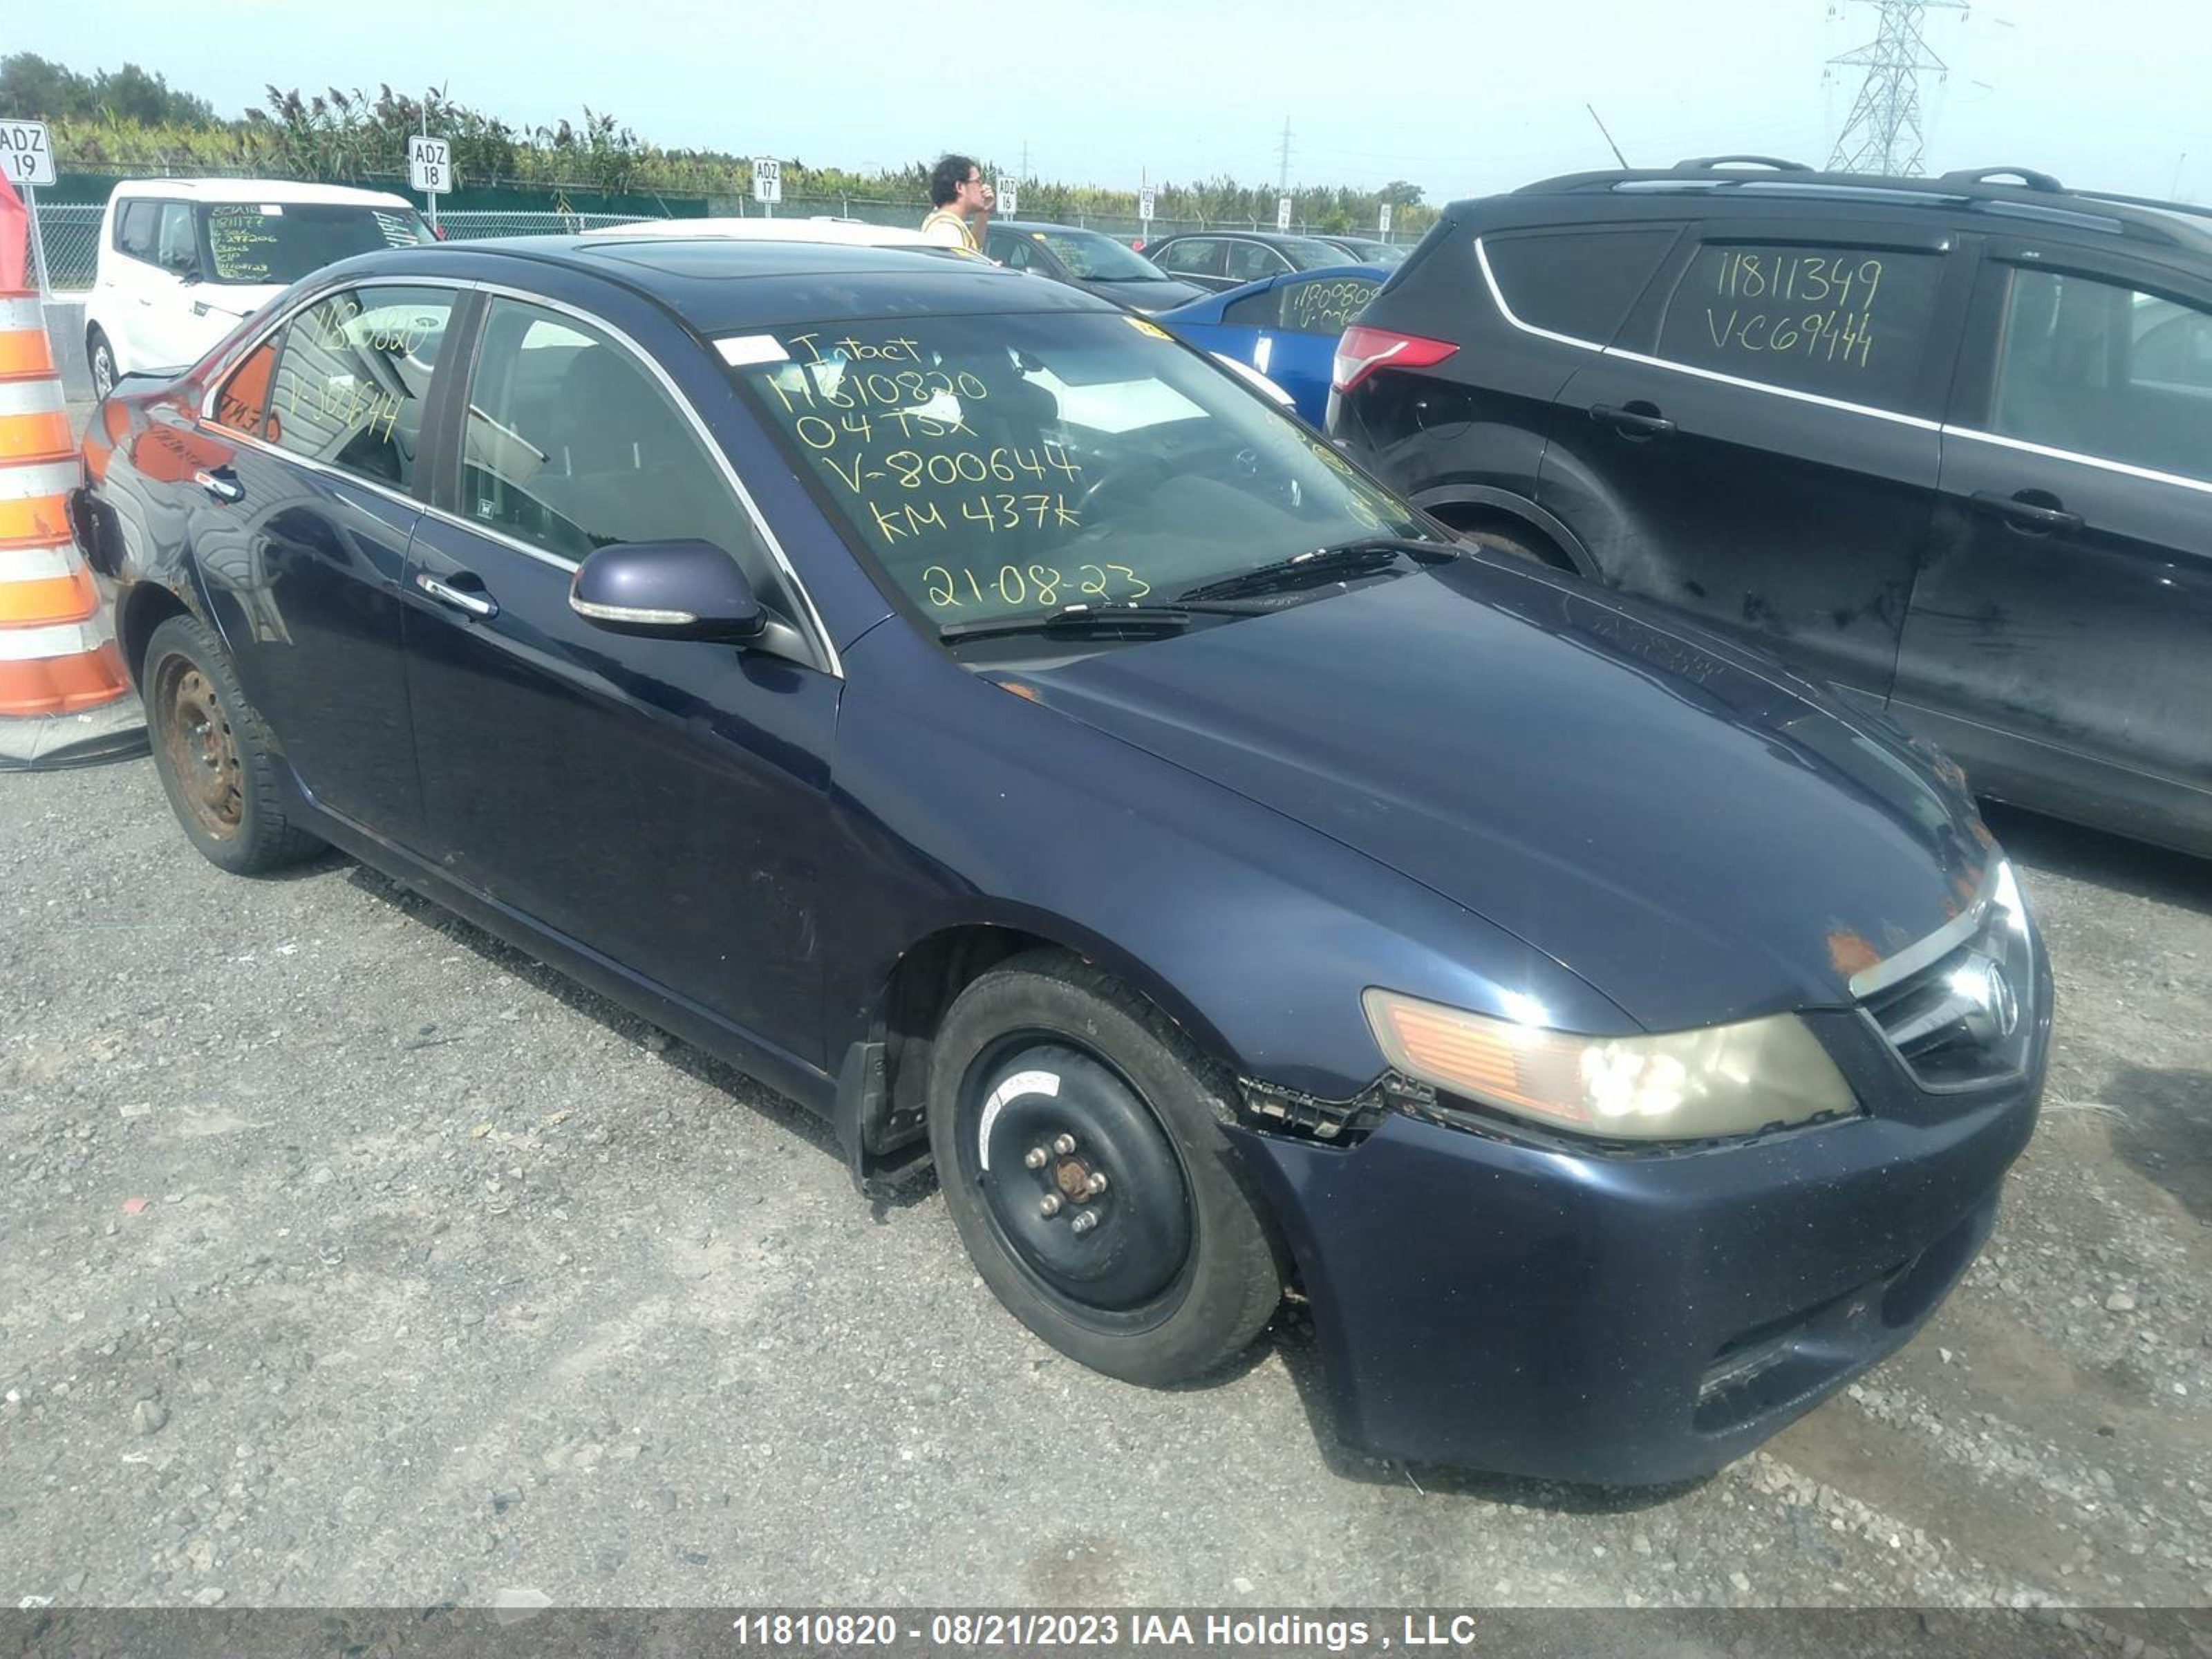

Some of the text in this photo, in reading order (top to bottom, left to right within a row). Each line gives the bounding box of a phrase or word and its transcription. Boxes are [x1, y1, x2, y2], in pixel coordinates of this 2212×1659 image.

[0, 127, 44, 151] ADZ
[13, 154, 36, 176] 19
[415, 144, 446, 165] ADZ
[424, 165, 440, 185] 18
[757, 162, 778, 179] ADZ
[762, 180, 773, 197] 17
[1718, 252, 1882, 309] 11811349
[787, 333, 922, 367] Intact
[765, 371, 987, 413] 11810820
[796, 415, 872, 448] 04
[822, 445, 1081, 494] V-800644
[923, 564, 1151, 608] 21-08-23
